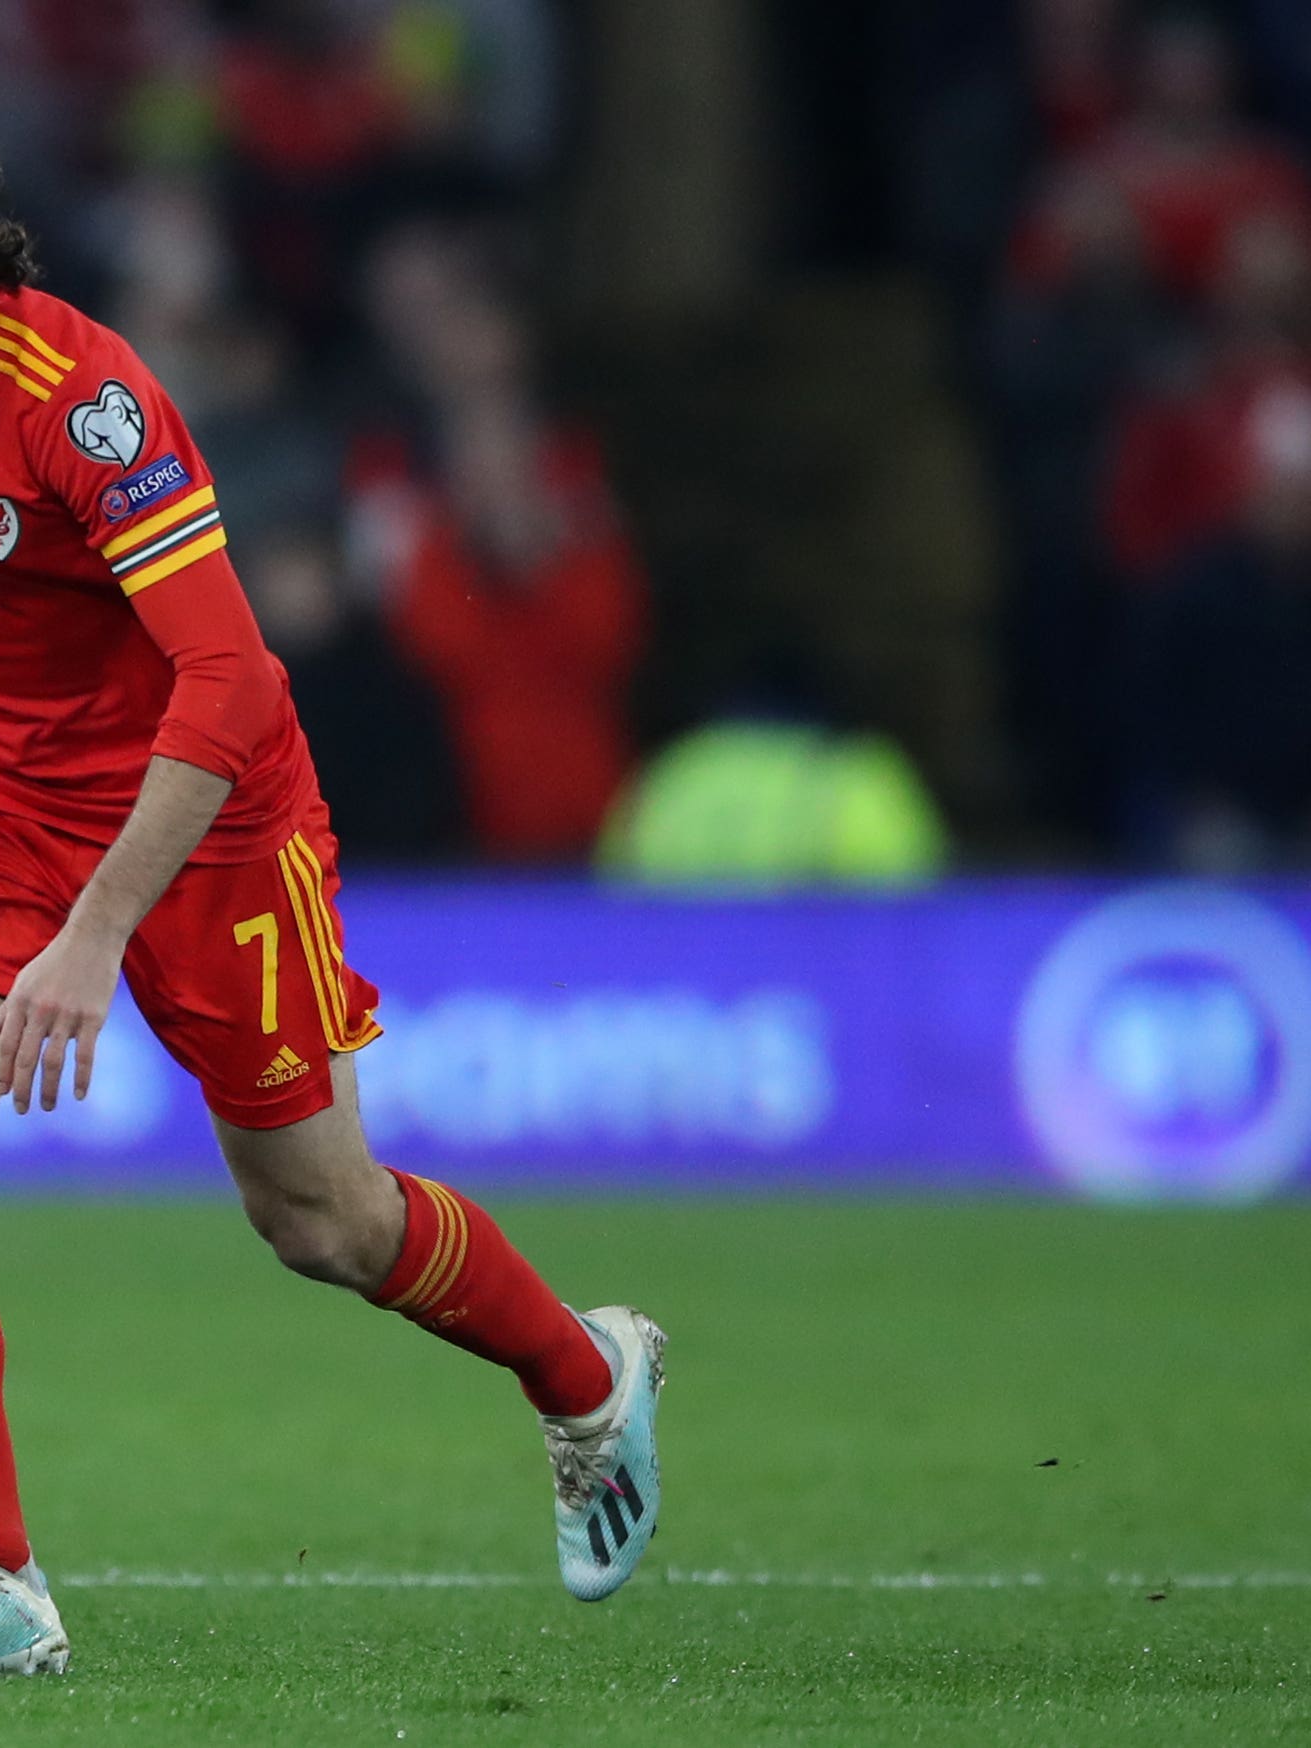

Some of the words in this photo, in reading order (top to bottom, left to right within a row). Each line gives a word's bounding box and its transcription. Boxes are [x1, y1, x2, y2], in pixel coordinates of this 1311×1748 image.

[128, 461, 184, 502] RESPECT
[233, 912, 278, 1035] 7
[256, 1061, 310, 1088] adidas
